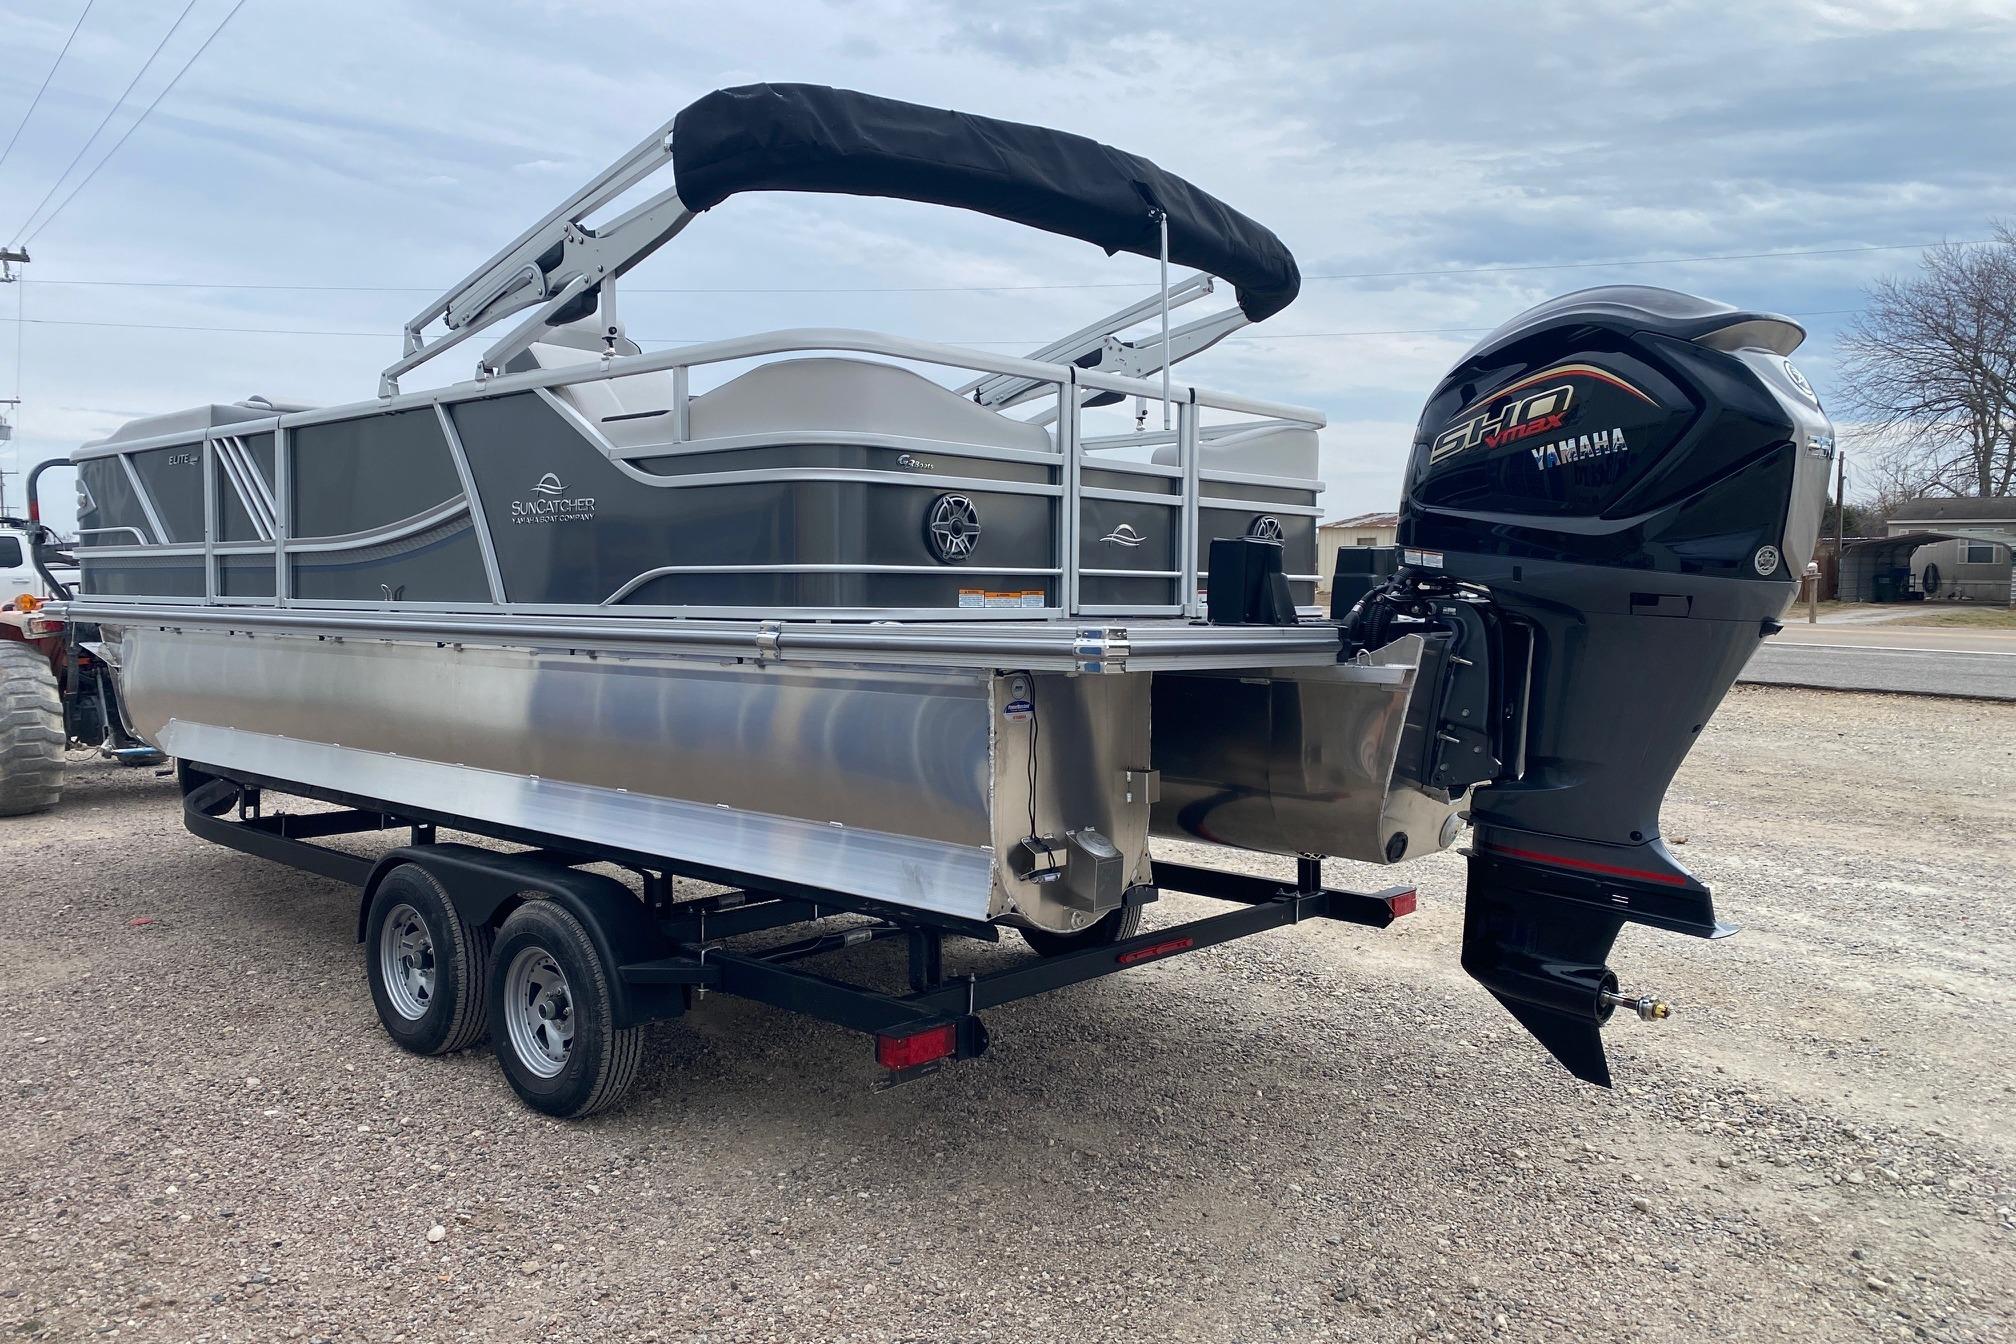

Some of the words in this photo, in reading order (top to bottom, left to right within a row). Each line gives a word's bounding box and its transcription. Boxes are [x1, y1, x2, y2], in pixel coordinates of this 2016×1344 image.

[1429, 385, 1574, 465] SHO
[168, 453, 190, 465] ELITE
[1531, 427, 1628, 471] YAMAHA
[511, 517, 539, 525] YAMAHA
[540, 515, 559, 523] BOAT
[560, 513, 595, 522] COMPANY
